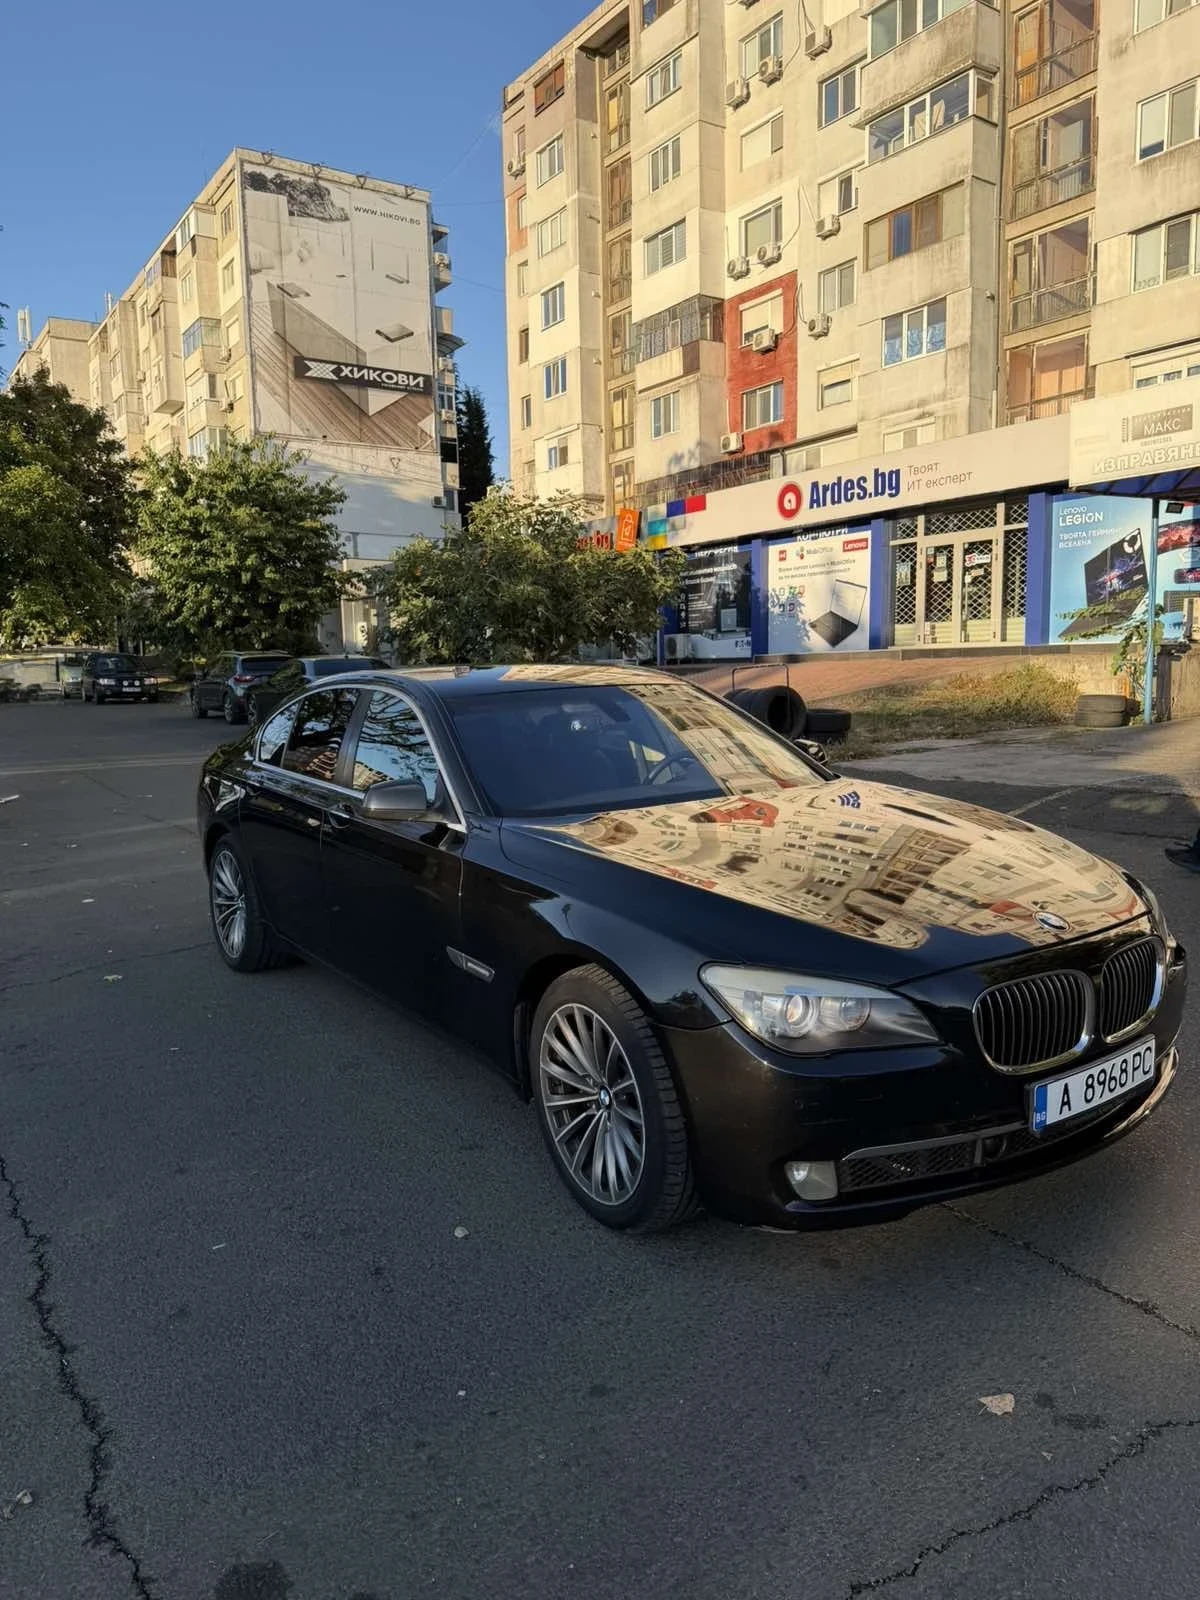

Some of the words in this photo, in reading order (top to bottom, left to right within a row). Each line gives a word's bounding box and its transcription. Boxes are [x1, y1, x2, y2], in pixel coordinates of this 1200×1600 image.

[339, 364, 425, 388] ХИКОВИ
[1143, 418, 1182, 436] МАКС
[907, 462, 940, 476] Твоят
[808, 467, 901, 510] Ardes.bg
[907, 479, 922, 492] ИТ
[925, 471, 973, 489] експерт
[1059, 505, 1087, 516] Lenovo
[1059, 511, 1104, 526] LEGION
[1059, 1082, 1072, 1115] A
